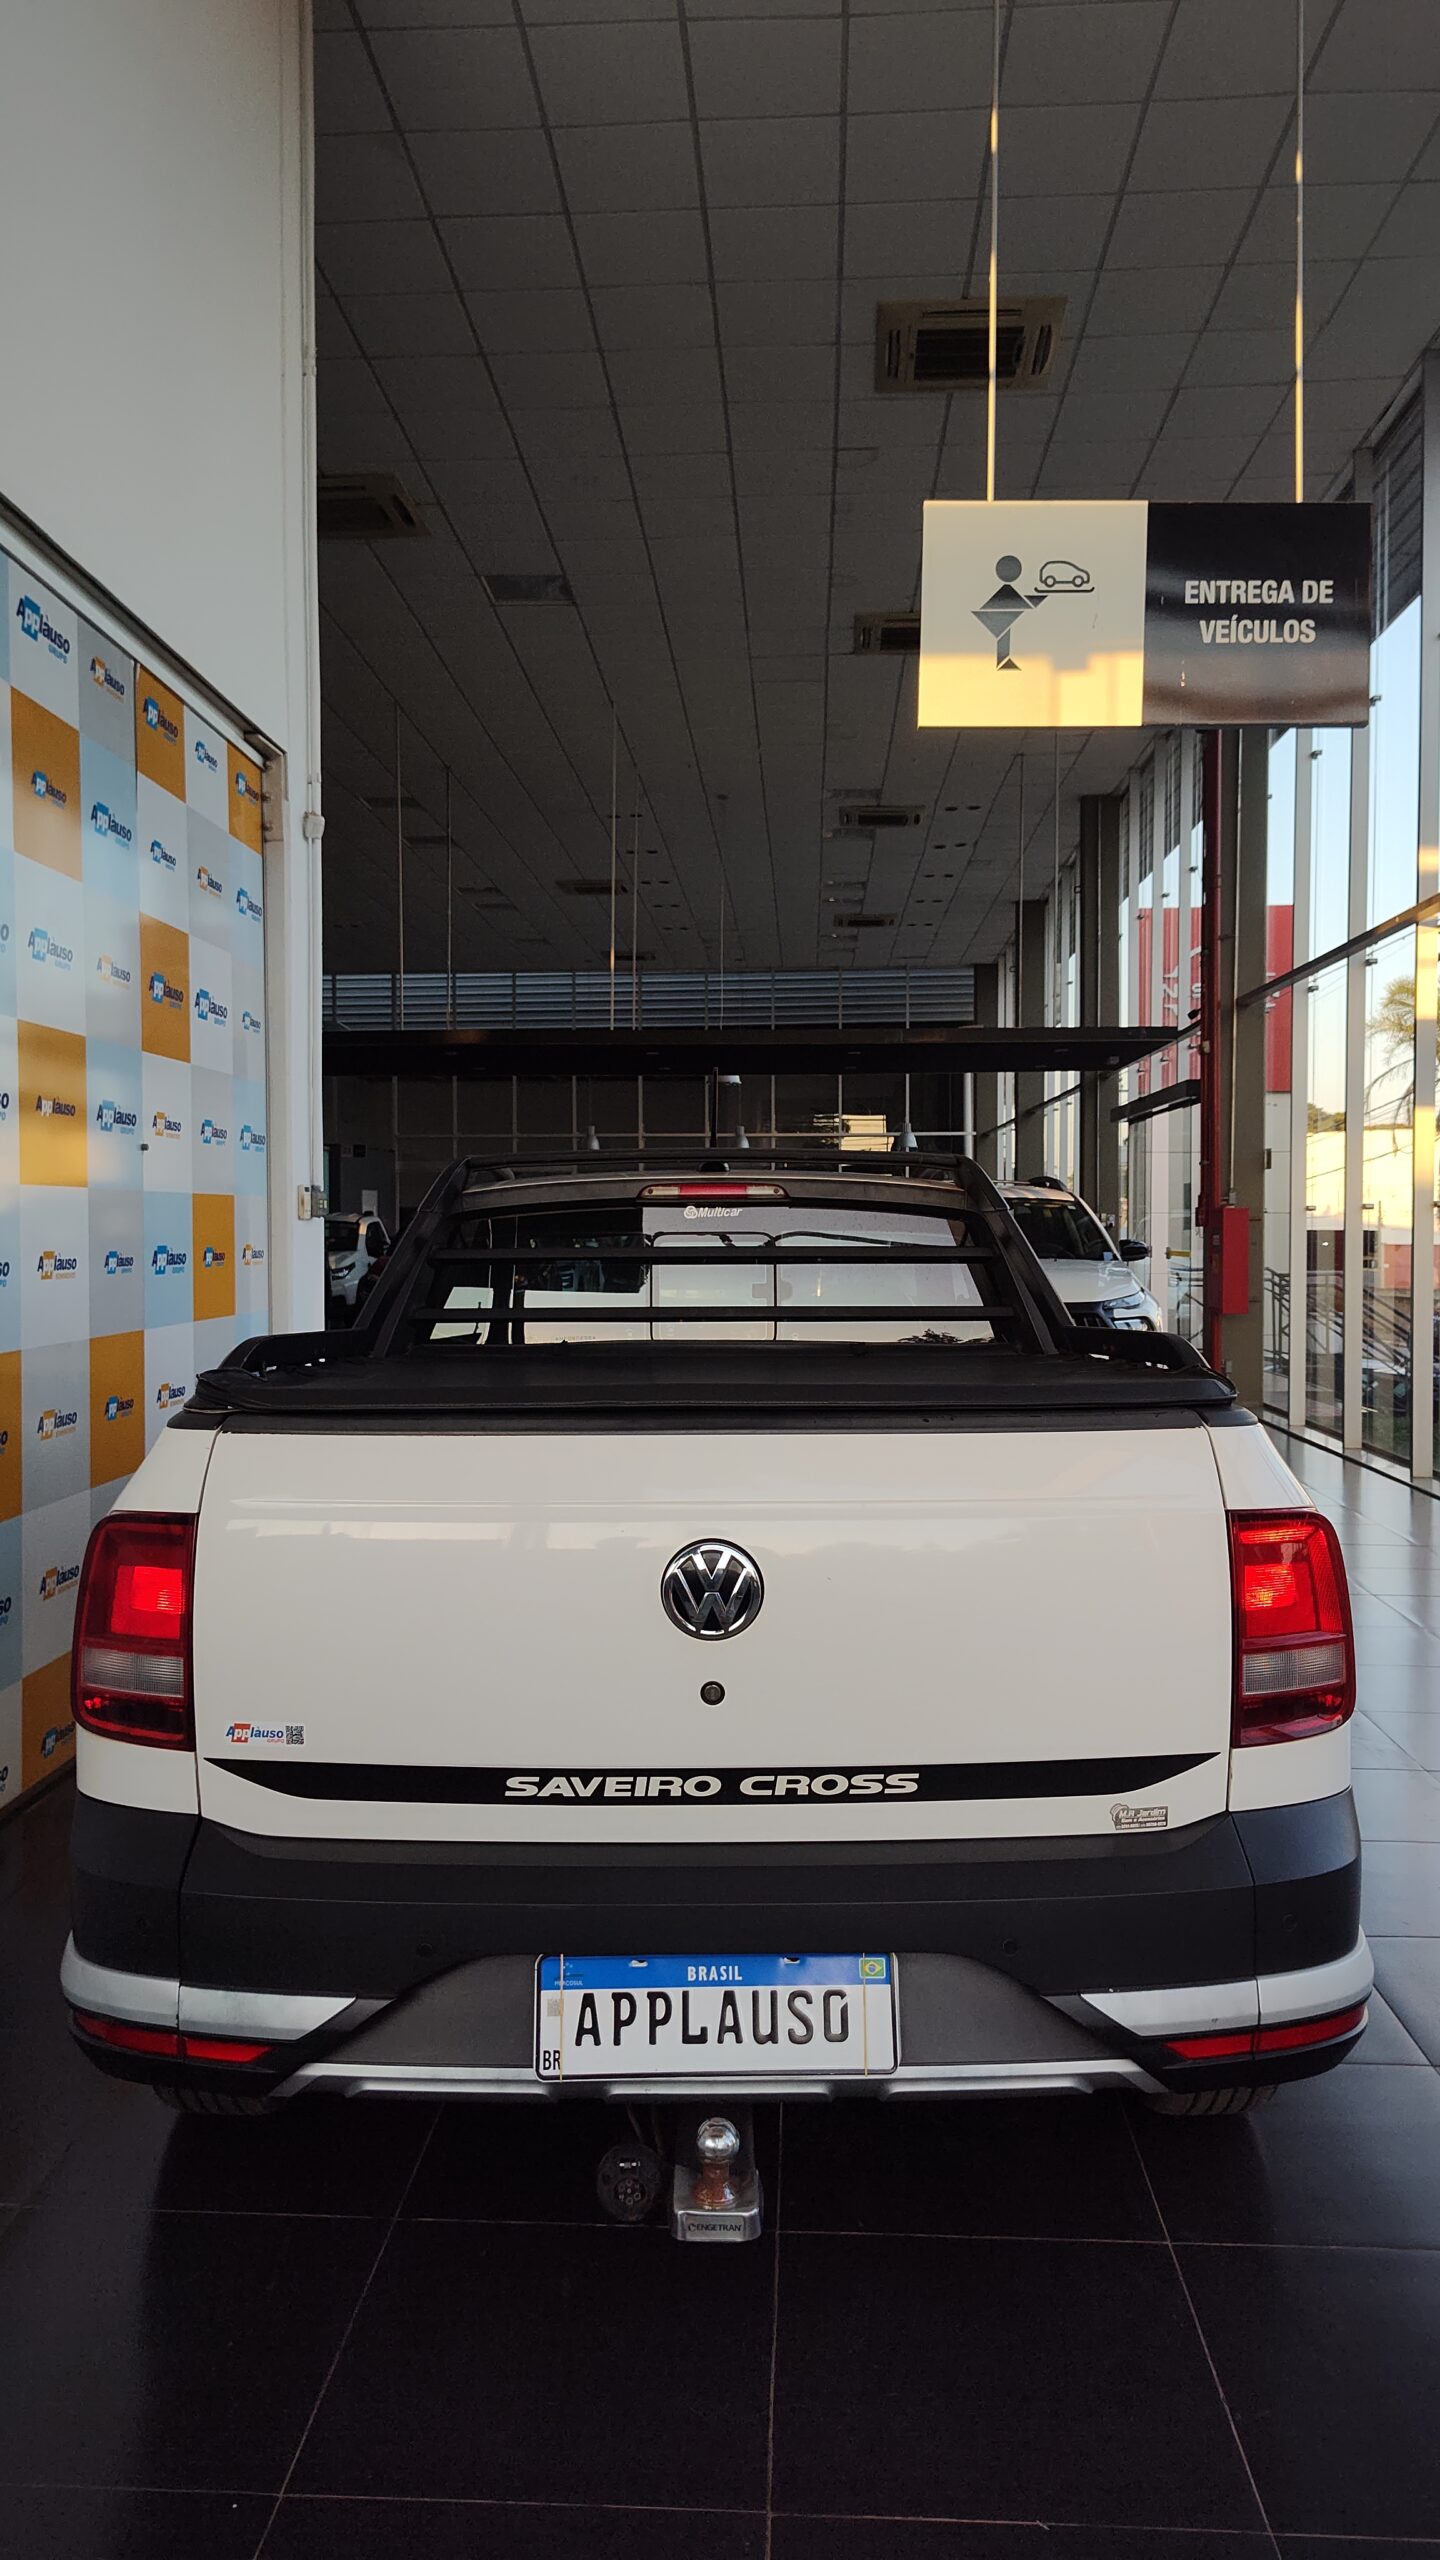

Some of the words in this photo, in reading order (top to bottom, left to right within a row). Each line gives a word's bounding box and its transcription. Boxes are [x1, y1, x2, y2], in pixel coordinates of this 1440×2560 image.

[1184, 580, 1295, 605] ENTREGA
[1302, 580, 1334, 605] DE
[1199, 614, 1316, 644] VEÍCULOS
[697, 1207, 743, 1217] Multicar
[504, 1776, 722, 1797] SAVEIRO
[739, 1773, 920, 1796] CROSS
[687, 1965, 743, 1982] BRASIL
[574, 1989, 850, 2047] APPLAUSO
[542, 2050, 561, 2071] BR
